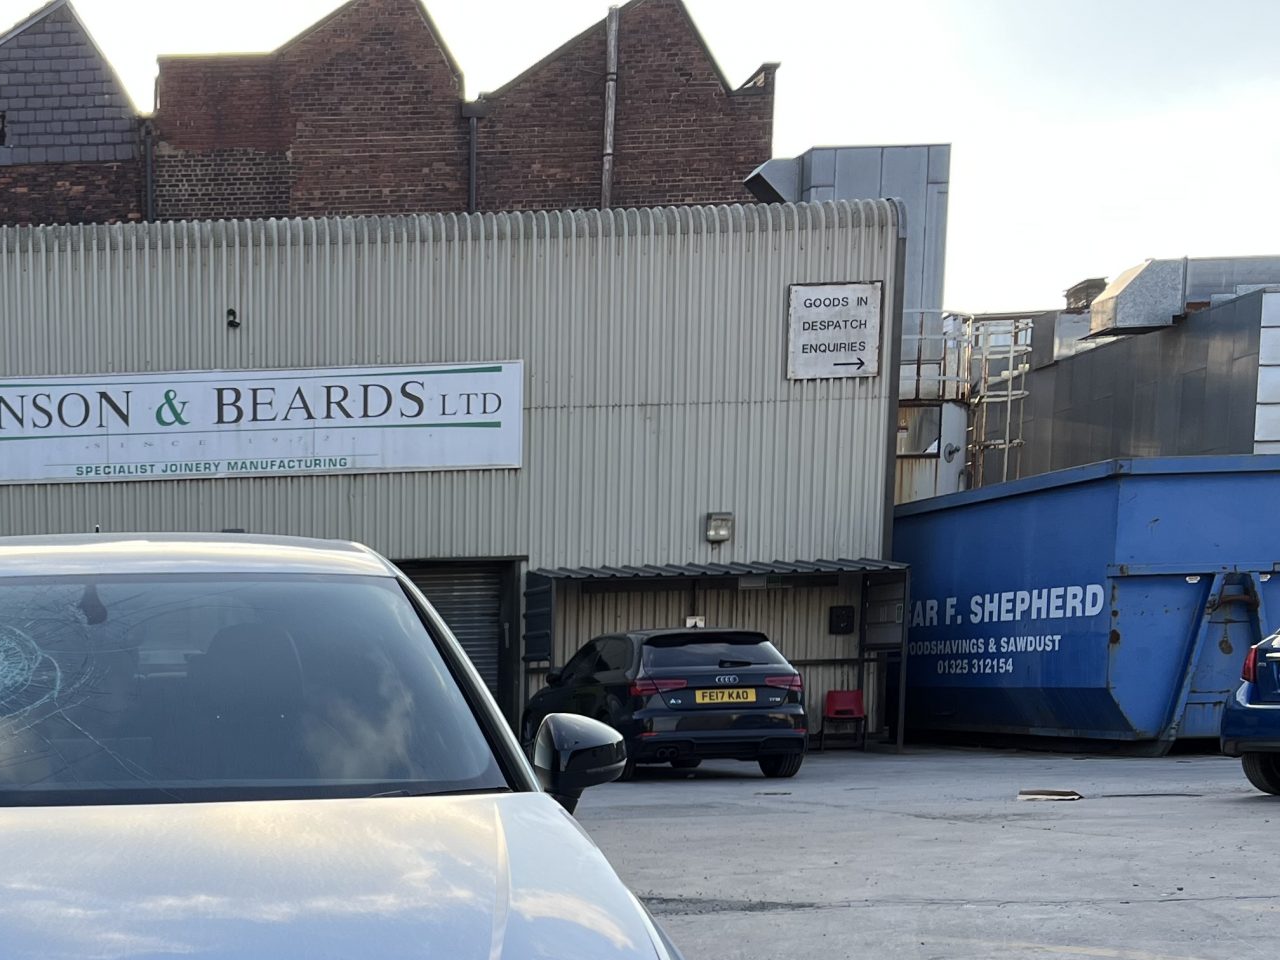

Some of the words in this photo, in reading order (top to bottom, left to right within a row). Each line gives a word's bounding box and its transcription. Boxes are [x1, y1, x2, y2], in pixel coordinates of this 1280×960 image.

[803, 297, 849, 308] GOODS
[856, 296, 868, 306] IN
[802, 319, 867, 331] DESPATCH
[801, 341, 866, 354] ENQUIRIES
[155, 389, 190, 427] &
[212, 380, 425, 425] BEARDS
[439, 392, 502, 416] LTD
[93, 438, 208, 449] SINCE
[75, 464, 155, 476] SPECIALIST
[161, 461, 220, 473] JOINERY
[227, 457, 348, 471] MANUFACTURING
[908, 599, 938, 628] AR
[945, 597, 962, 625] F.
[969, 583, 1105, 624] SHEPHERD
[908, 638, 985, 655] OODSHAVINGS
[988, 637, 997, 653] &
[1000, 634, 1062, 653] SAWDUST
[937, 659, 969, 674] 01325
[971, 657, 1014, 674] 312154
[701, 691, 725, 701] FE17
[727, 690, 749, 700] KAO
